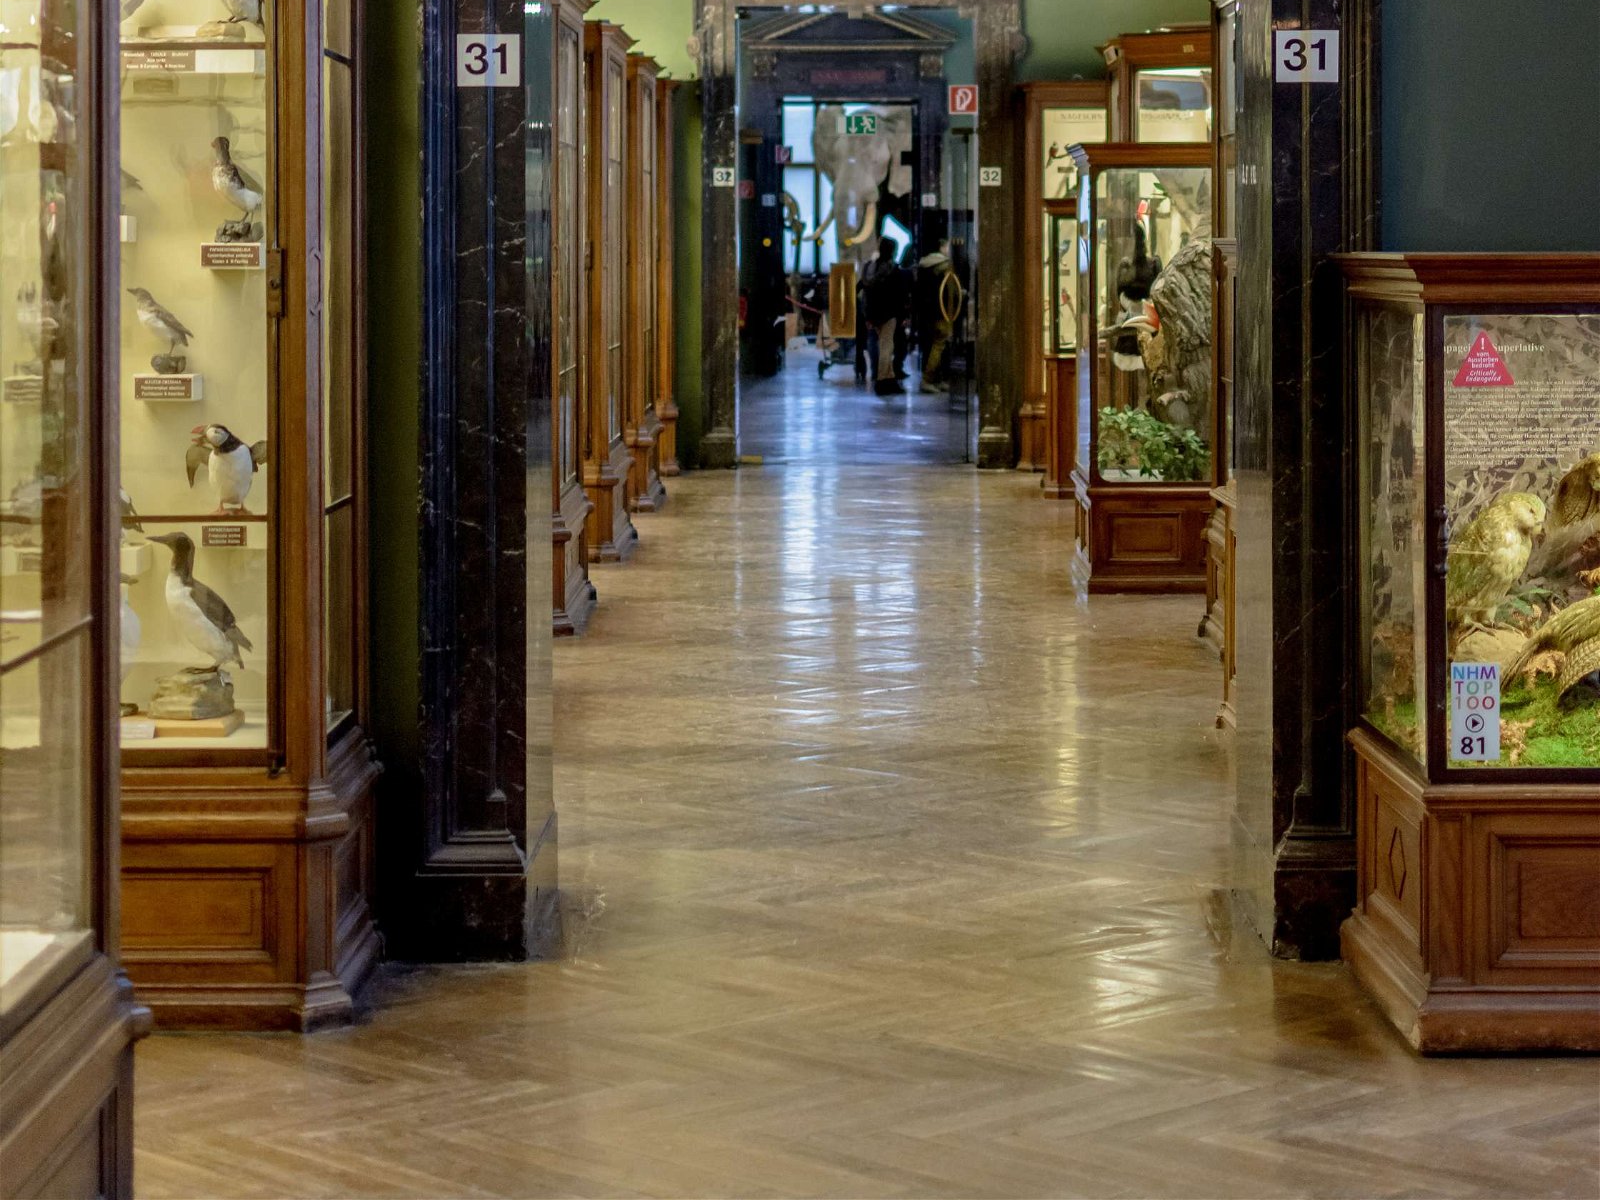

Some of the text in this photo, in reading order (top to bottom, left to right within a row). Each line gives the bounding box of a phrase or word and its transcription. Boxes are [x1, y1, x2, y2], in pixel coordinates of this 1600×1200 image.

[464, 42, 508, 75] 31
[1283, 38, 1326, 71] 31
[715, 170, 732, 182] 32
[983, 170, 999, 182] 32
[1465, 375, 1502, 384] Endangered
[1469, 369, 1498, 377] Critically
[1453, 666, 1496, 680] NHM
[1455, 681, 1493, 695] TOP
[1456, 696, 1495, 710] 100
[1460, 736, 1485, 755] 81
